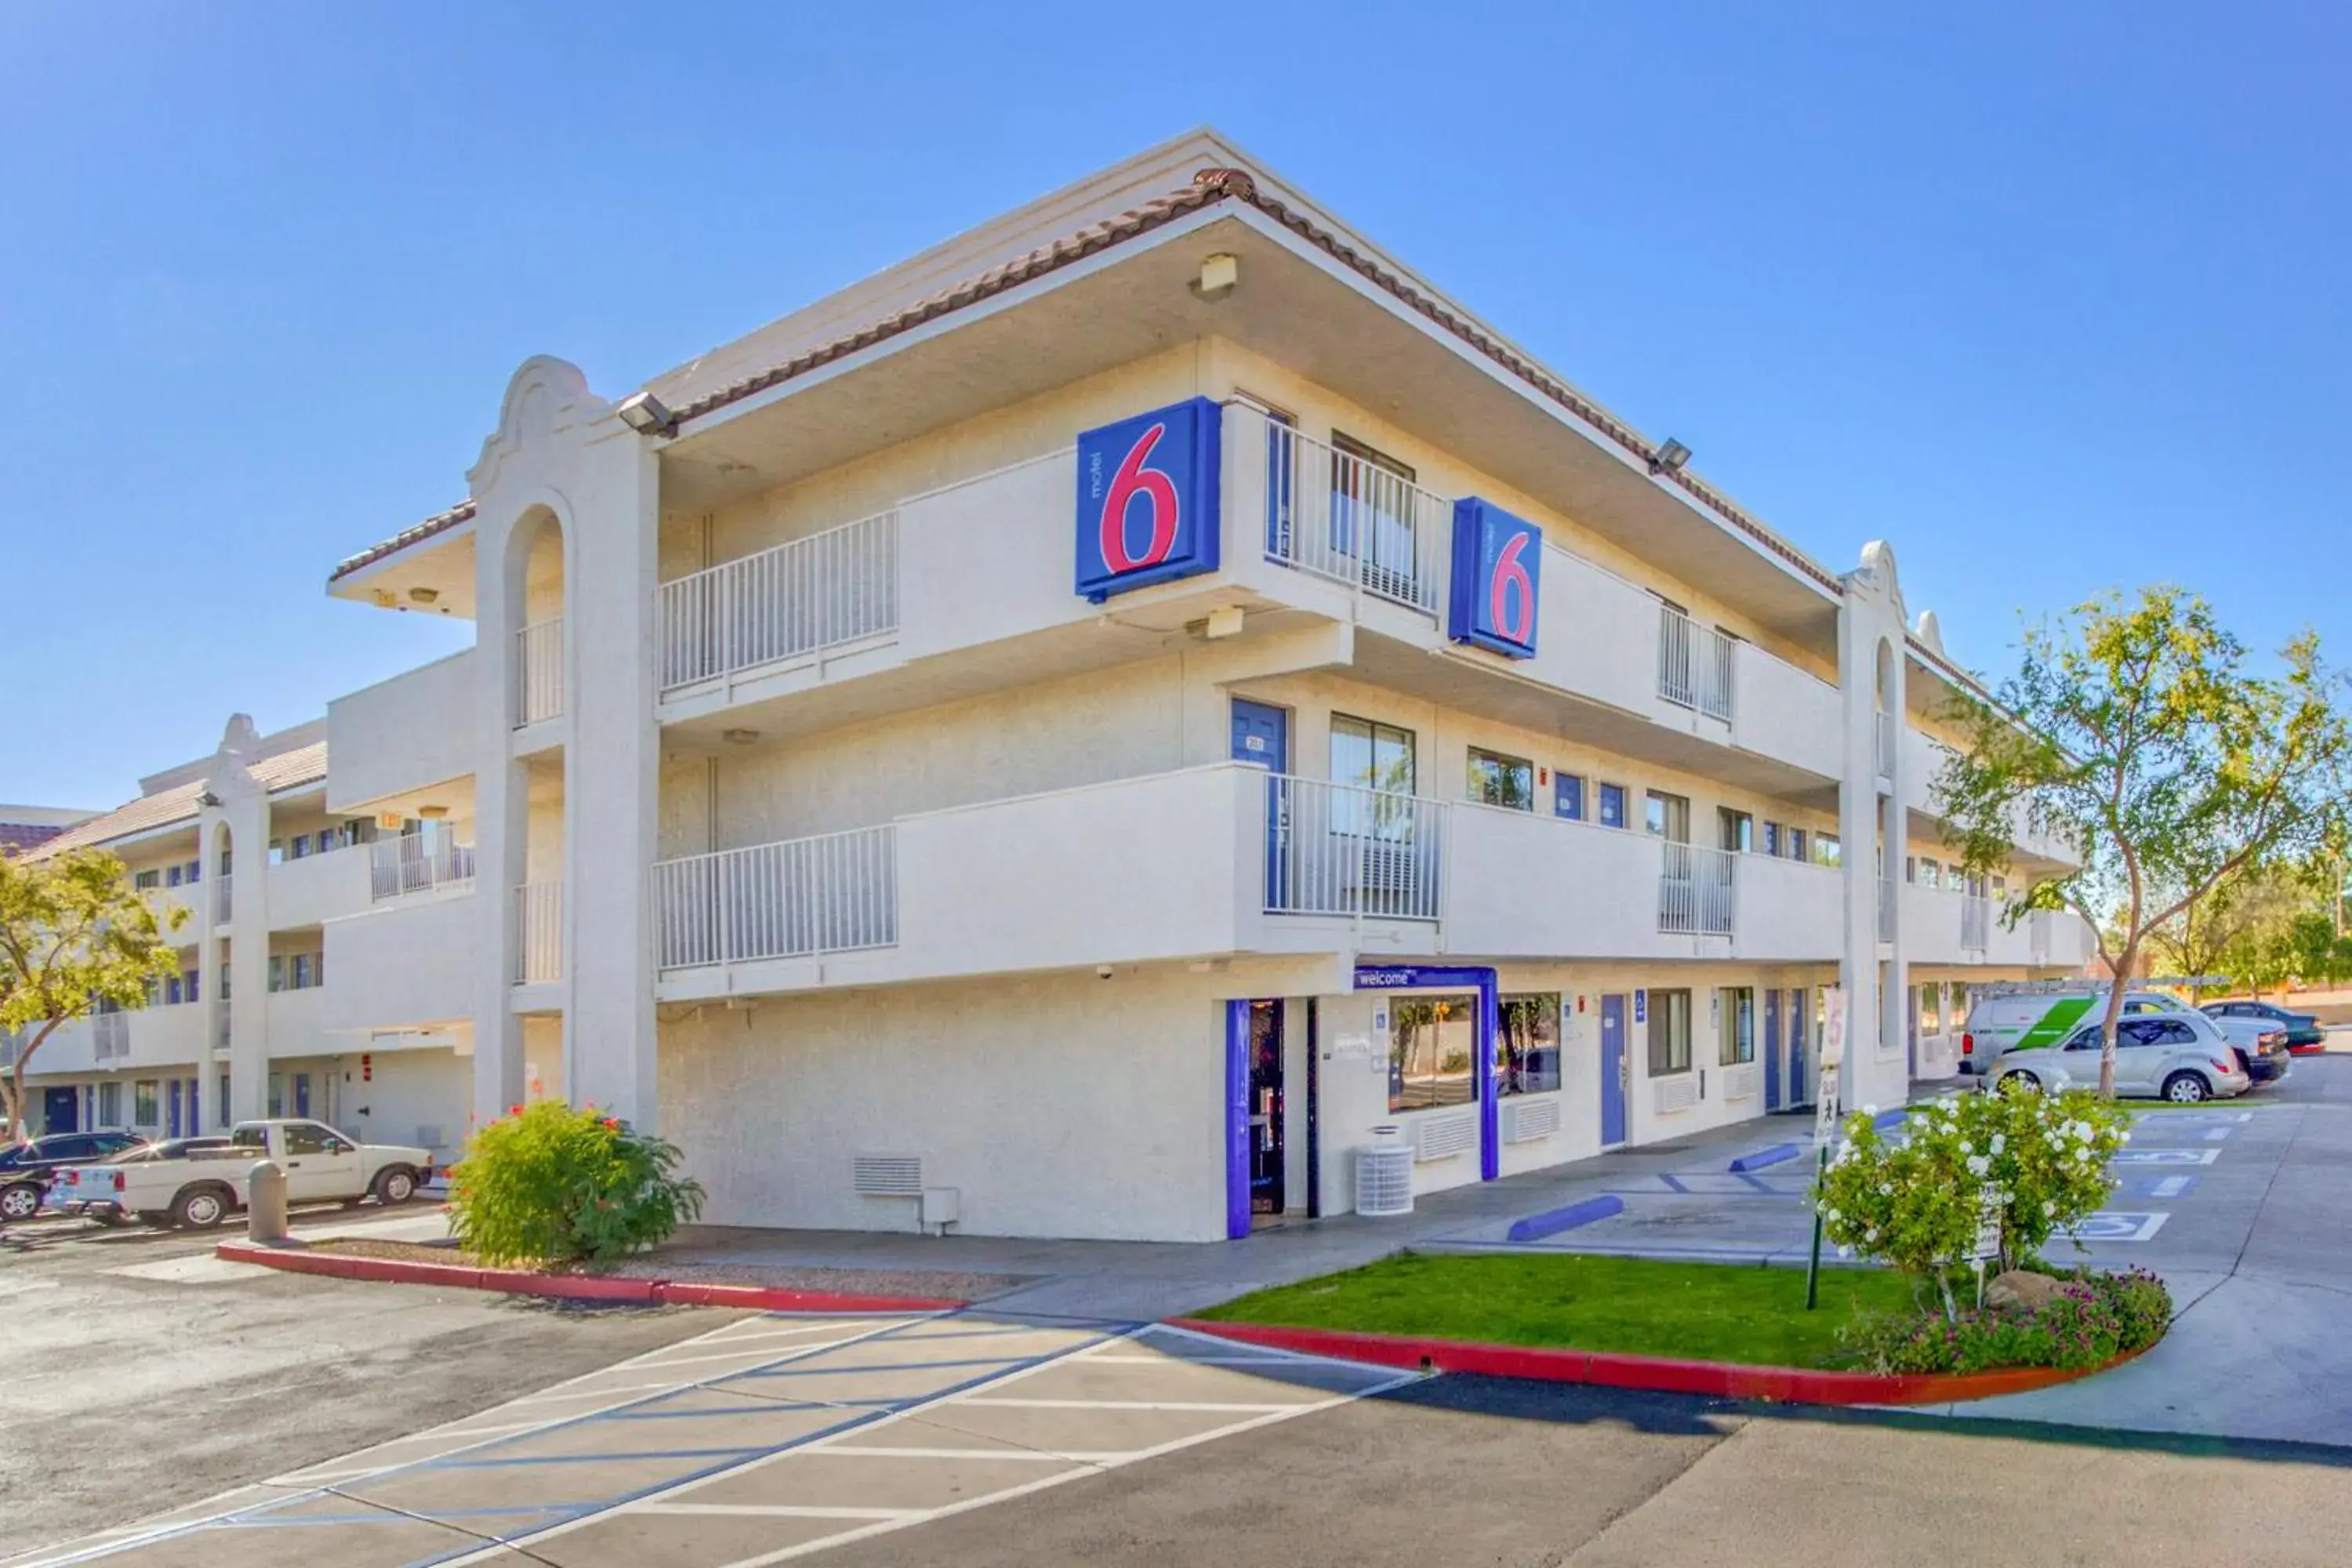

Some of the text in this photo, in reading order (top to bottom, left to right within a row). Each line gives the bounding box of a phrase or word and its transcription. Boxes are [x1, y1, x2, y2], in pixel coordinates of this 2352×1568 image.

[1090, 452, 1102, 499] motel
[1100, 422, 1180, 575] 6
[1491, 532, 1534, 644] 6
[1360, 971, 1409, 985] welcome
